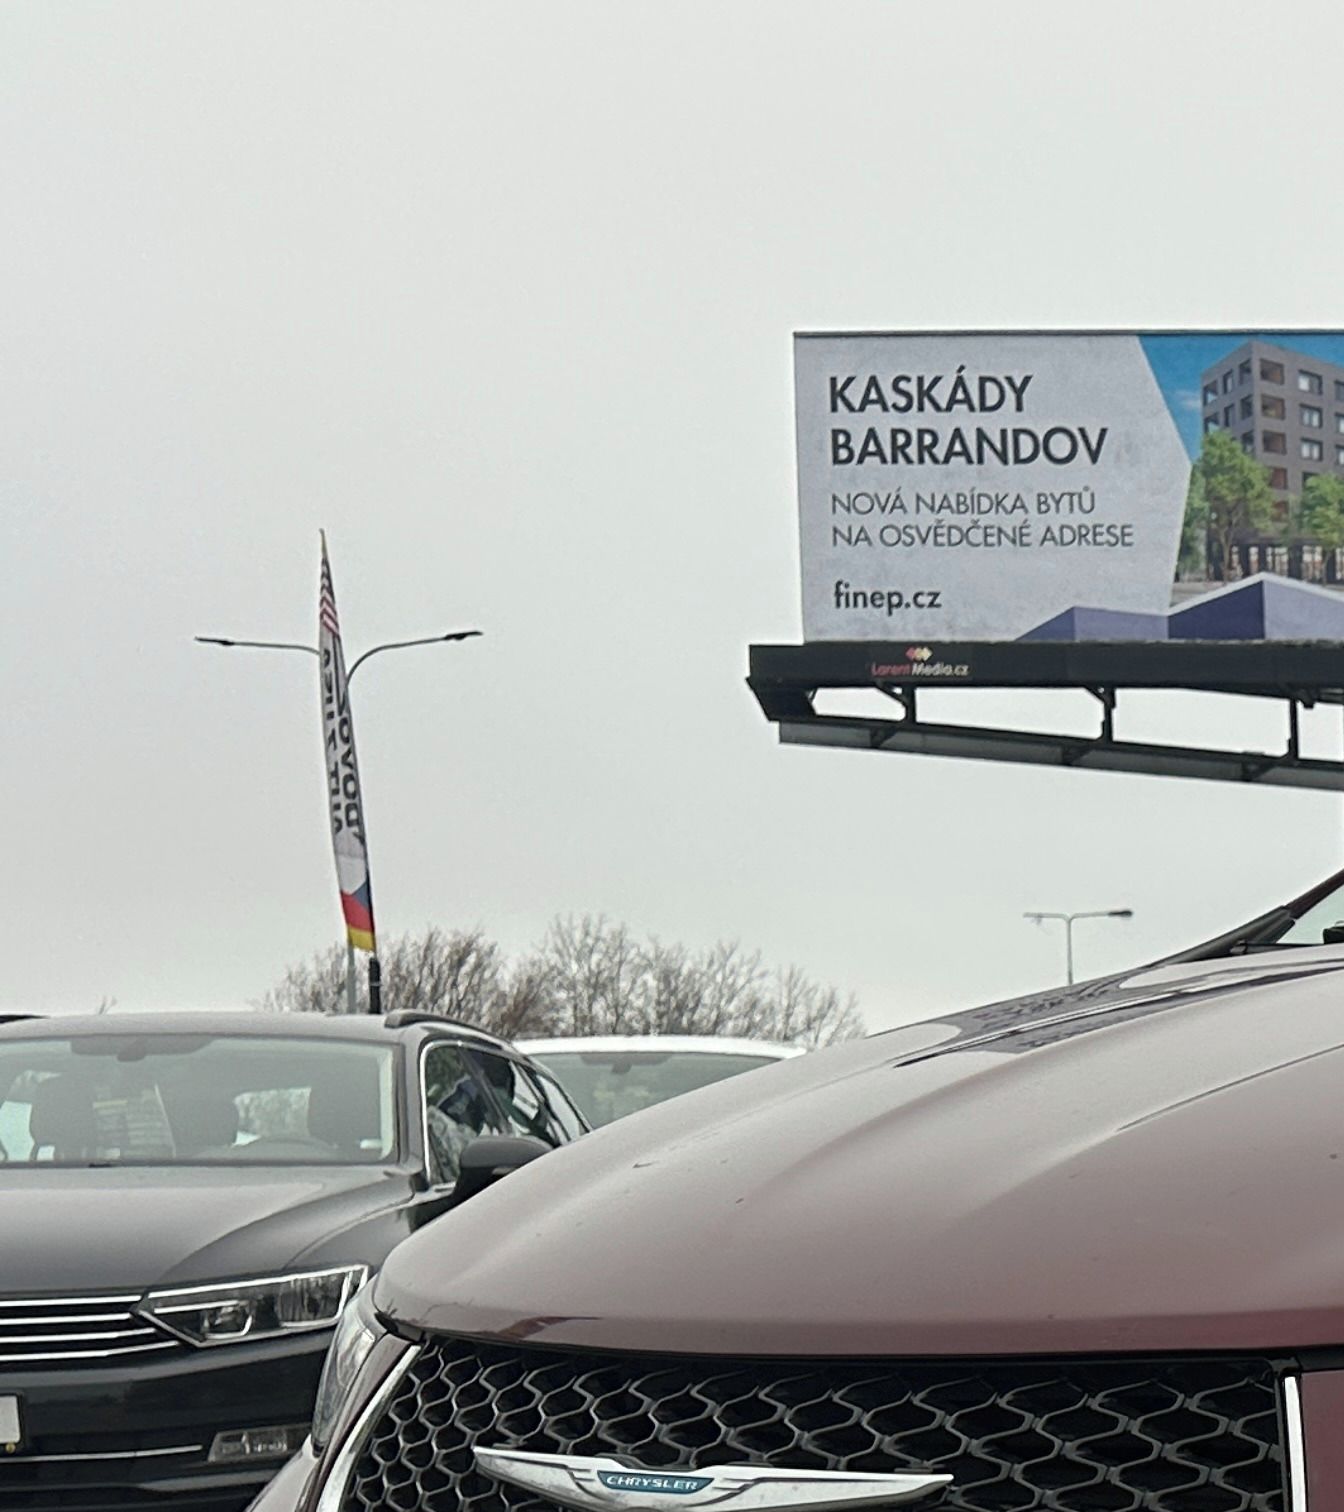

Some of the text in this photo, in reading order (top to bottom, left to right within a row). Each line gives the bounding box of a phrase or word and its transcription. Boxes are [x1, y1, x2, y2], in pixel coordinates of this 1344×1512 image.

[829, 365, 1033, 413] KASKÁDY
[831, 426, 1108, 466] BARRANDOV
[831, 486, 1095, 515] NOVÁ NABÍDKA BYTŮ
[832, 519, 1134, 547] NA OSVĚDČENÉ ADRESE
[834, 579, 942, 616] finep.cz
[606, 1475, 698, 1490] CHRYSLER
